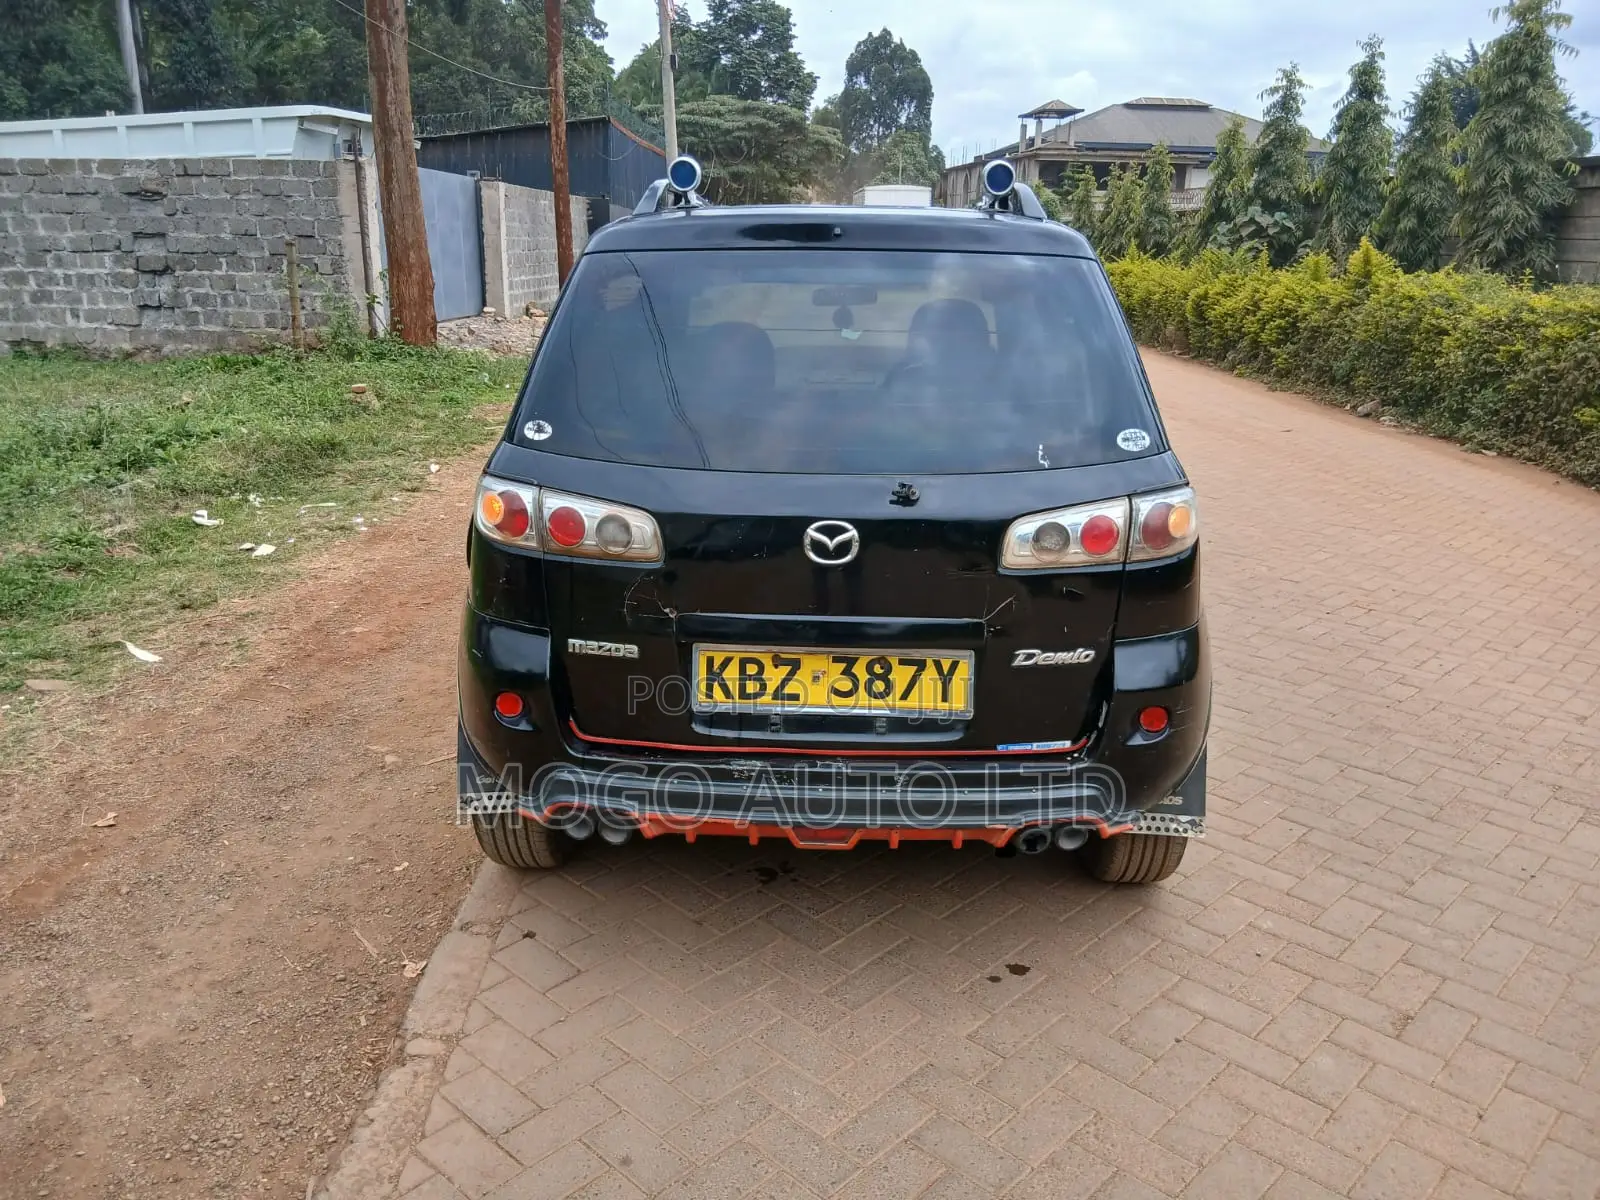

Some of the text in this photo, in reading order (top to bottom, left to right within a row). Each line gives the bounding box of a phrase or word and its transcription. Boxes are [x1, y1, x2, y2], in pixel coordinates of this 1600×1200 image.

[1011, 647, 1096, 666] Demio
[704, 655, 961, 703] KBZ 387Y
